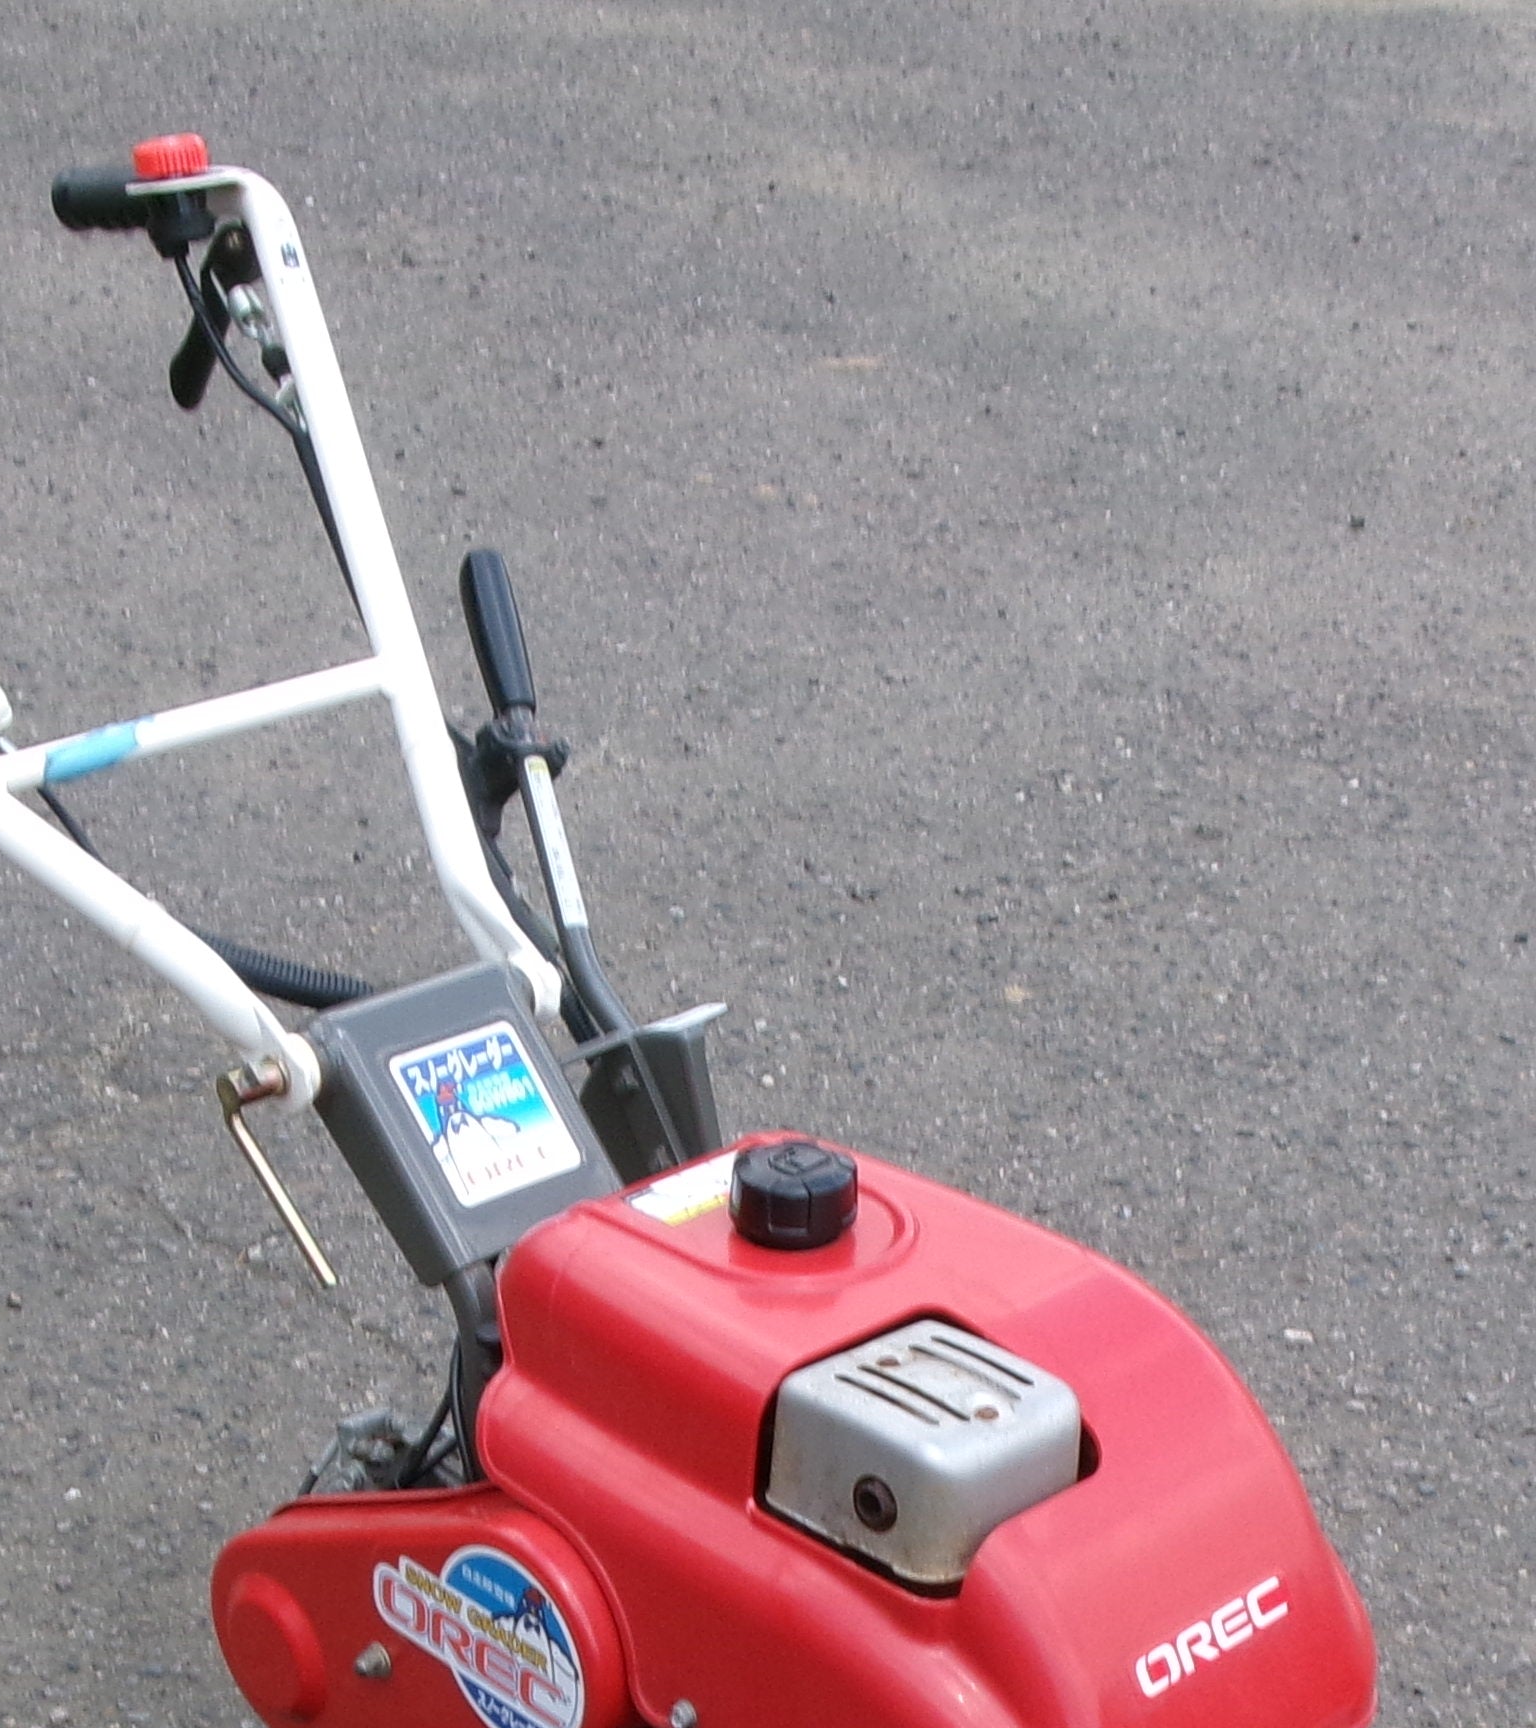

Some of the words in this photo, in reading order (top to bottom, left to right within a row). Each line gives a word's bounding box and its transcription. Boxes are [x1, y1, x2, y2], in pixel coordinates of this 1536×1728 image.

[407, 1034, 513, 1096] スノーグレーダー
[381, 1579, 564, 1728] OREC
[405, 1564, 463, 1614] SNOW
[467, 1606, 548, 1673] GRADER
[1135, 1575, 1289, 1699] OREC
